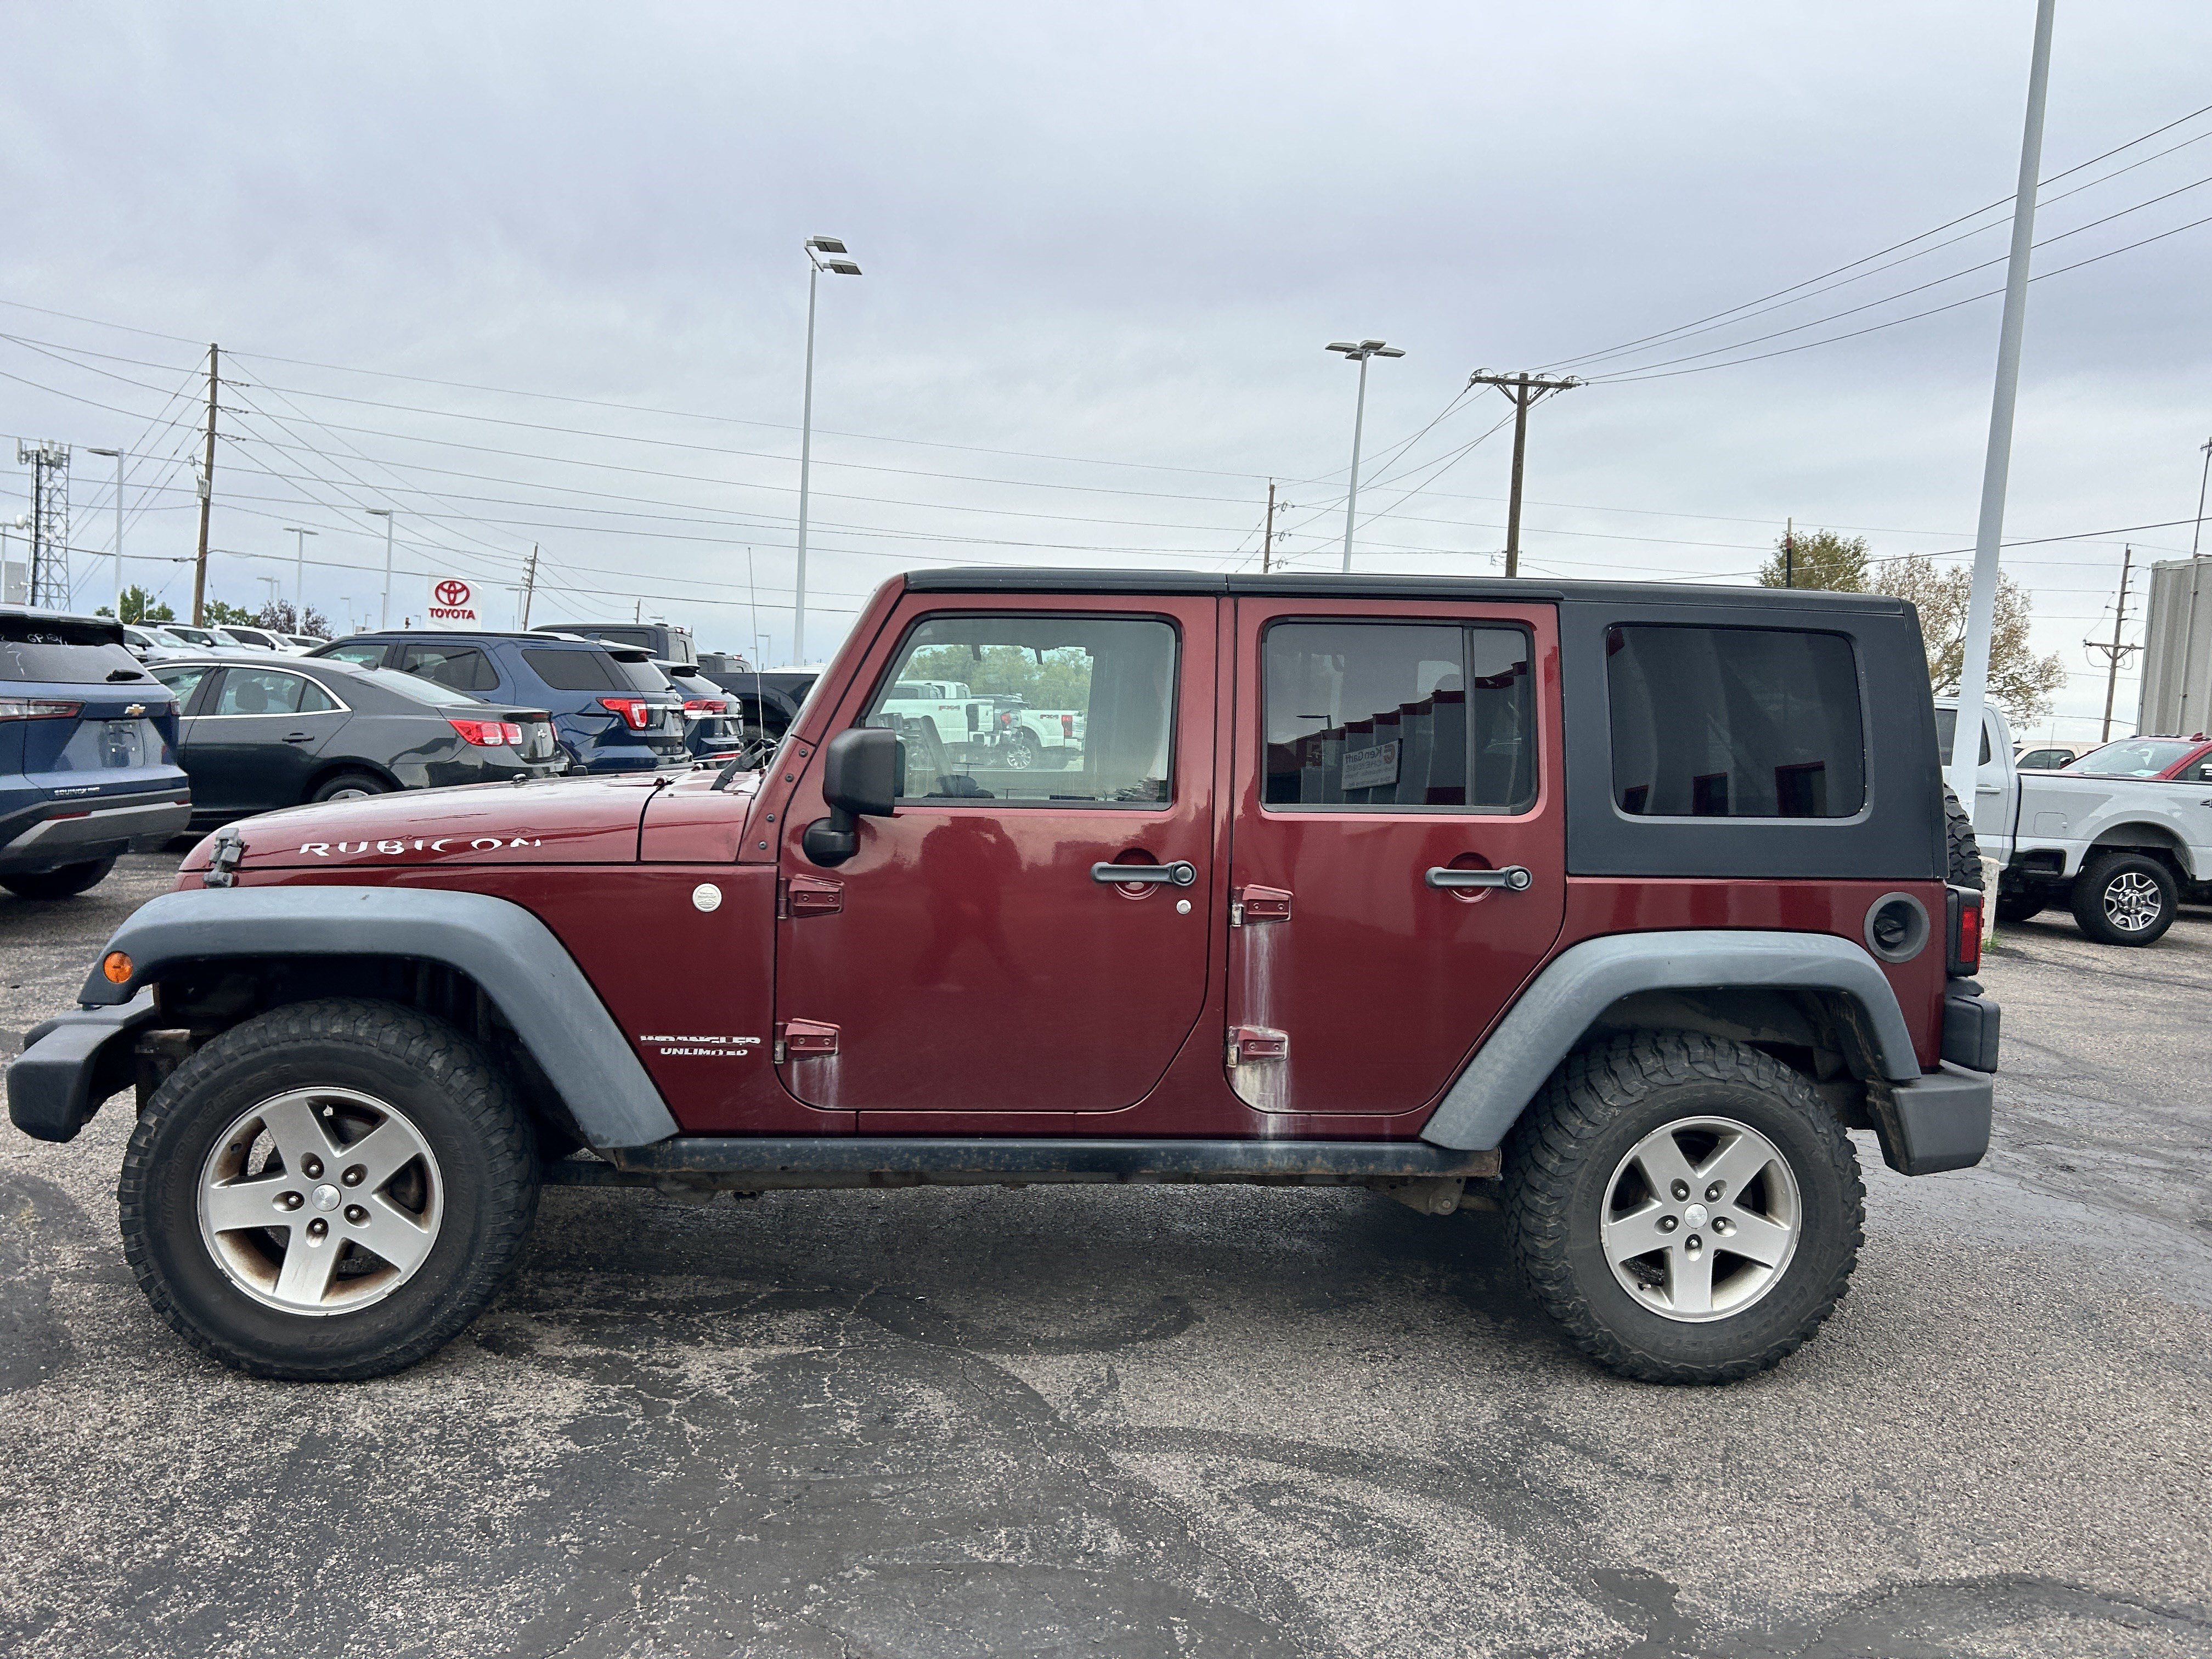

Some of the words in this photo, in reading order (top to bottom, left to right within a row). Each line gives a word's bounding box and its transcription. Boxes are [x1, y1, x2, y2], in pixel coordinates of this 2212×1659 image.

[428, 607, 476, 620] TOYOTA
[299, 837, 542, 856] RUBICON
[660, 1047, 748, 1056] UNLIMITED
